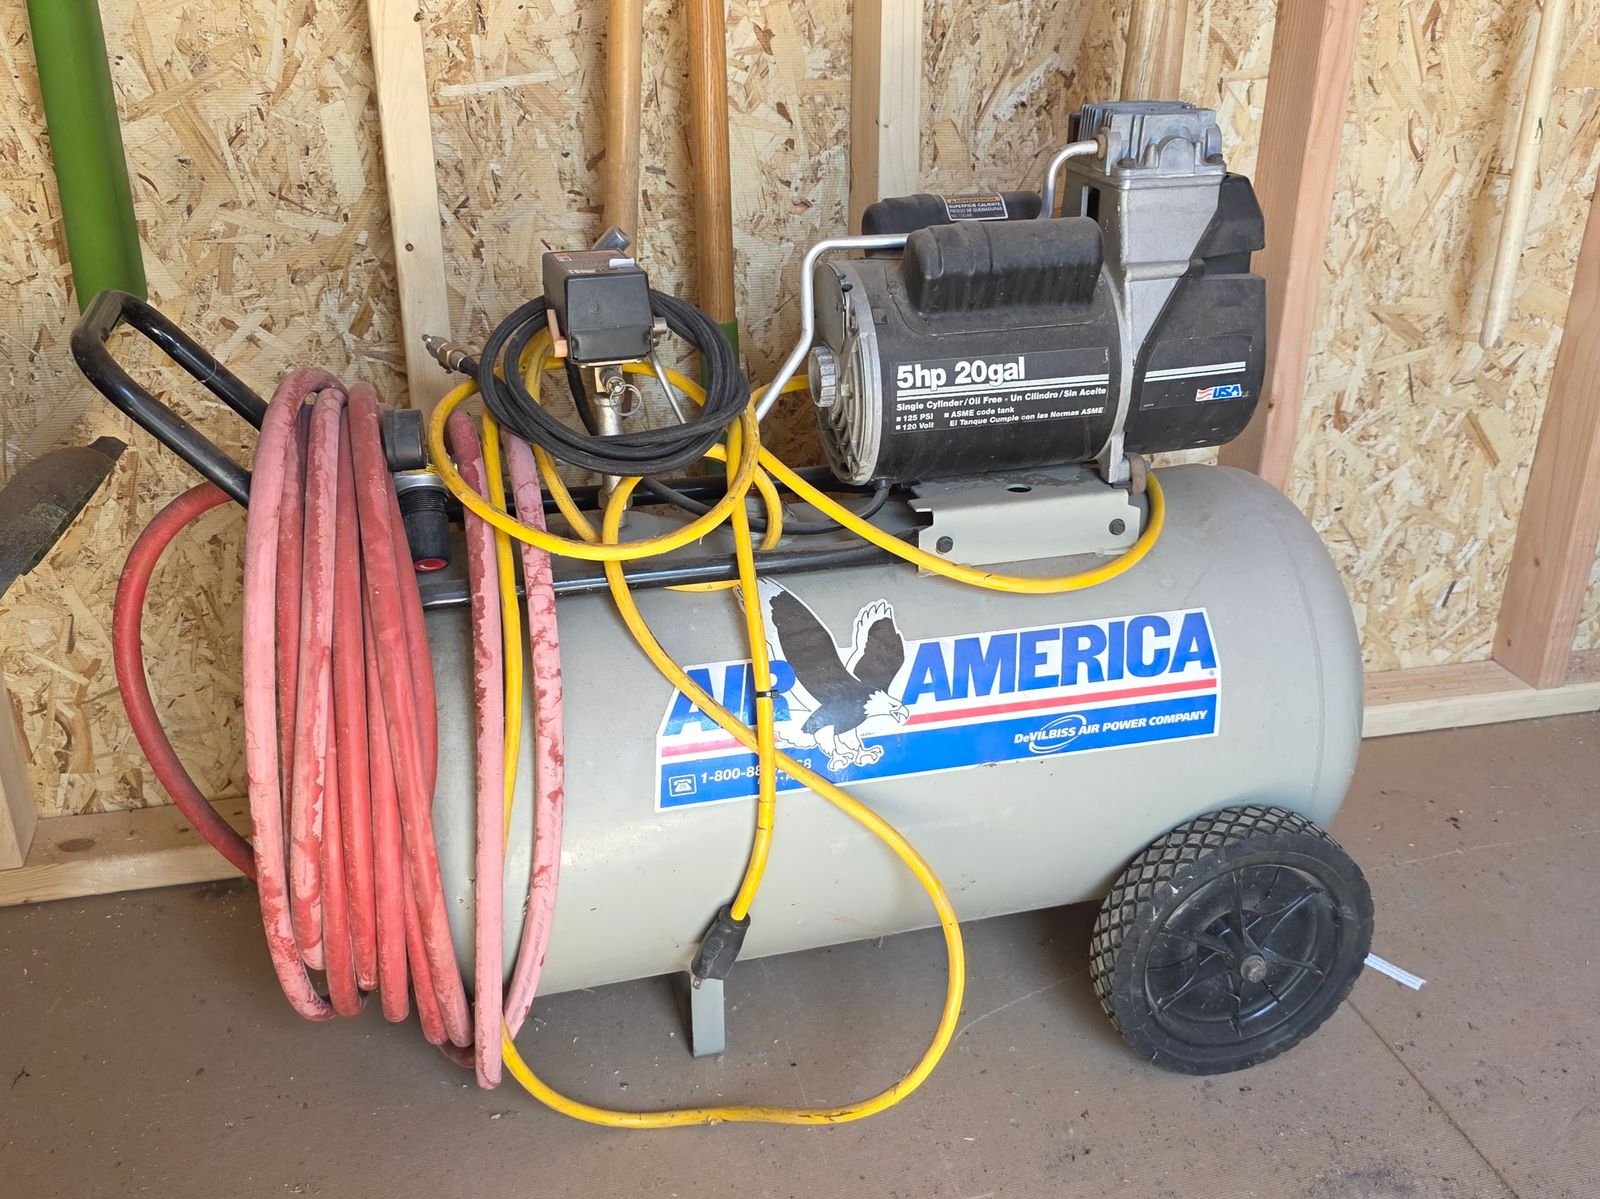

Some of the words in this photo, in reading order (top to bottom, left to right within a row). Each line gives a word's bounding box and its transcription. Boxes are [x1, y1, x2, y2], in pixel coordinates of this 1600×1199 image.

[896, 363, 947, 391] 5hp
[954, 357, 1026, 387] 20gal
[896, 402, 924, 411] Single
[926, 396, 981, 410] Cylinder/Oil
[983, 396, 1003, 404] Free
[1010, 394, 1023, 402] Un
[1024, 389, 1078, 401] Cilindro/Sin
[1079, 387, 1106, 396] Aceite
[1212, 384, 1242, 399] USA
[902, 414, 918, 422] 125
[950, 409, 975, 418] ASME
[976, 407, 995, 416] code
[997, 406, 1015, 414] tank
[959, 418, 988, 426] Tanque
[989, 413, 1019, 423] Cumple
[1050, 409, 1079, 418] Normas
[1080, 407, 1104, 415] ASME
[662, 659, 796, 736] AIR
[902, 611, 1216, 706] AMERICA
[1014, 726, 1076, 744] DeVILBISS
[1078, 723, 1100, 736] AIR
[1102, 718, 1147, 733] POWER
[1148, 710, 1208, 726] COMPANY
